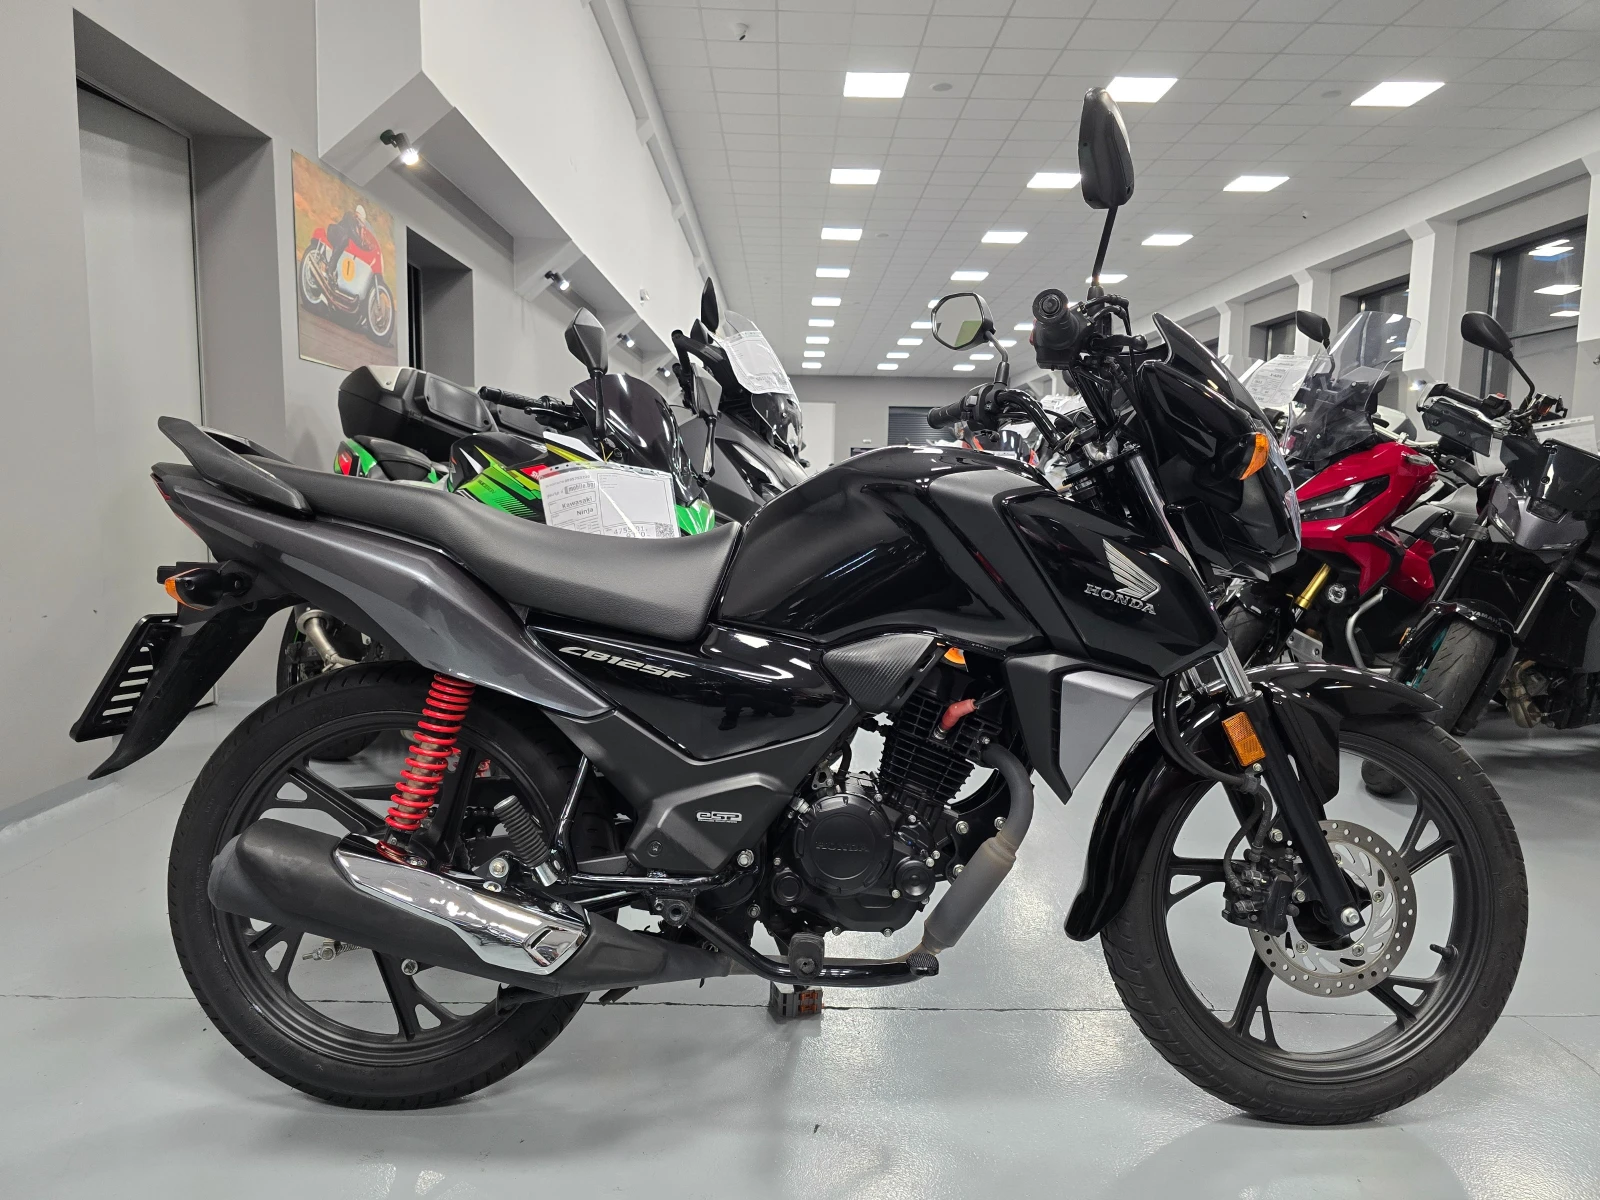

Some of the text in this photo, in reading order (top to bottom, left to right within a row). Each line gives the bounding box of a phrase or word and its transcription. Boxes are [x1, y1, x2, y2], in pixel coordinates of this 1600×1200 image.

[561, 496, 593, 509] Kawasaki
[576, 507, 594, 516] Ninja
[1083, 583, 1157, 615] HONDA
[1471, 610, 1502, 627] YAMAHA
[558, 646, 693, 678] CB125F
[815, 841, 870, 852] HONDA
